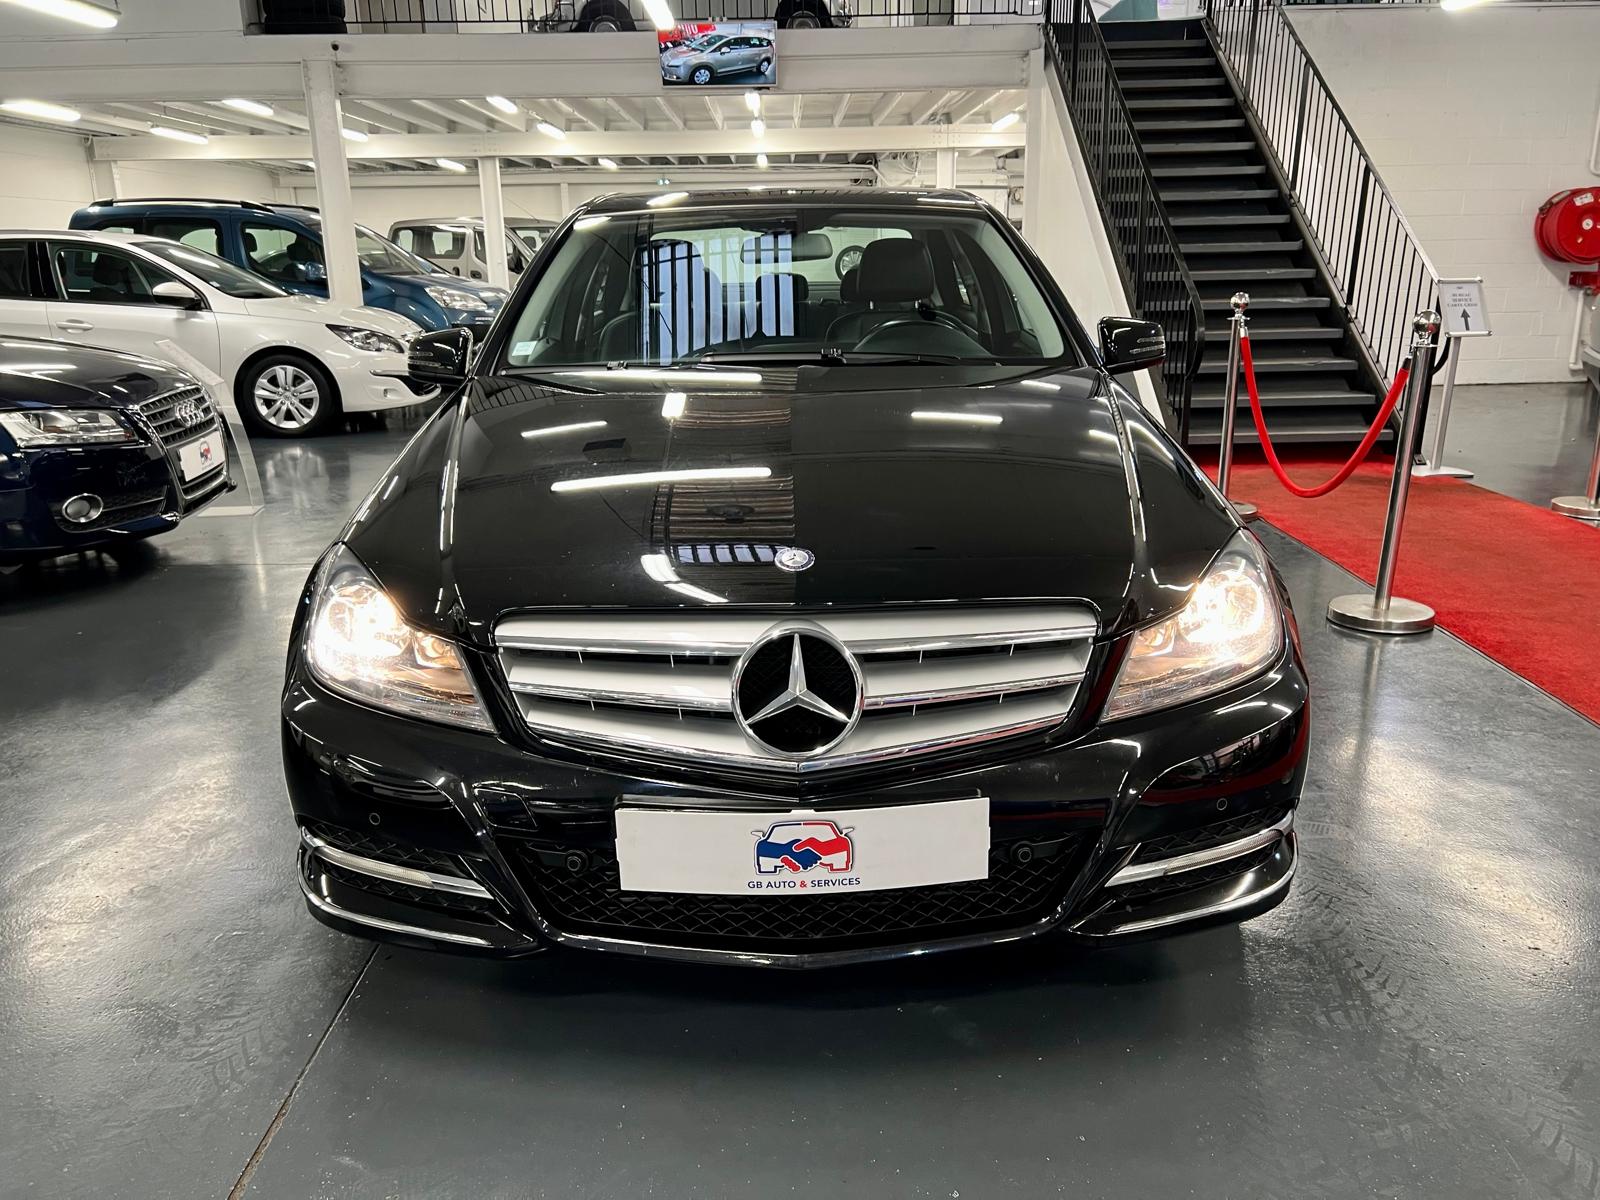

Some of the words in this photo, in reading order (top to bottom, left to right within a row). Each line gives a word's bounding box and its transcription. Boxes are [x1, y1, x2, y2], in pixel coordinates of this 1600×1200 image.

[747, 880, 763, 889] GB
[766, 880, 797, 889] AUTO
[799, 880, 808, 888] &
[810, 877, 861, 888] SERVICES
